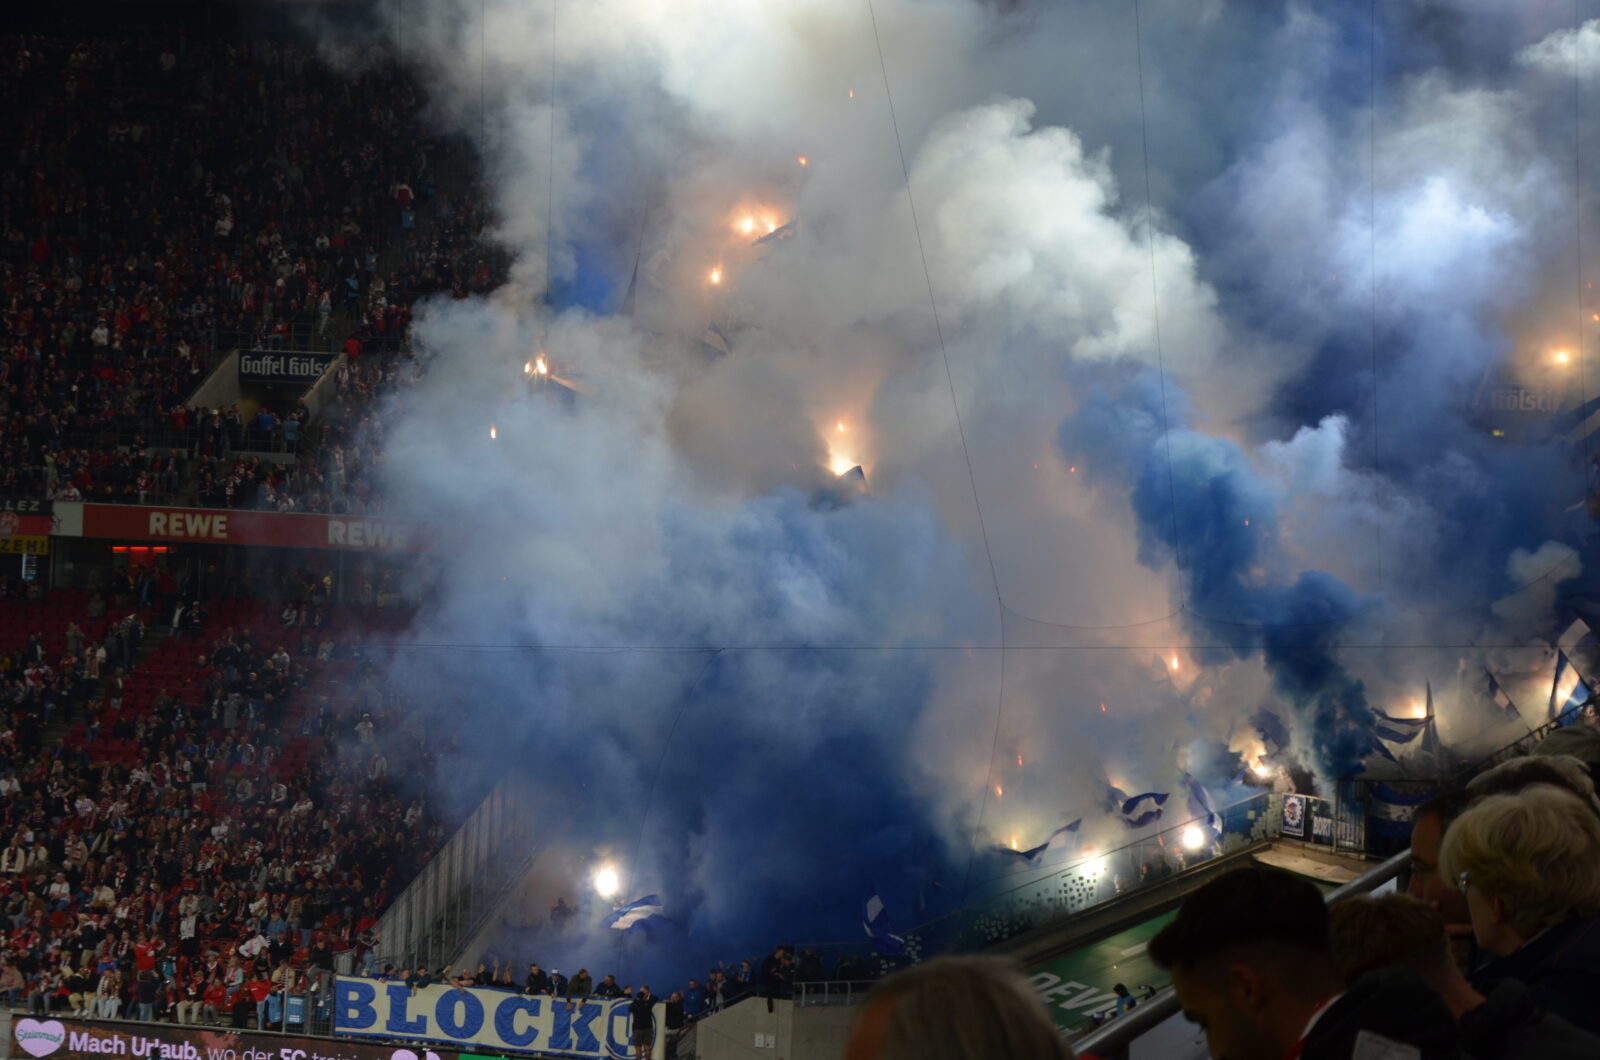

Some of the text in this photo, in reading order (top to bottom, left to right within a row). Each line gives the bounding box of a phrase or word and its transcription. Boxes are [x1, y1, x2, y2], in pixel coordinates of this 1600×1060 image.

[240, 355, 287, 376] Gaffel
[148, 511, 228, 539] REWE
[328, 520, 408, 548] REWE
[335, 981, 602, 1053] BLOCK
[69, 1032, 126, 1054] Mach
[207, 1047, 236, 1060] wo
